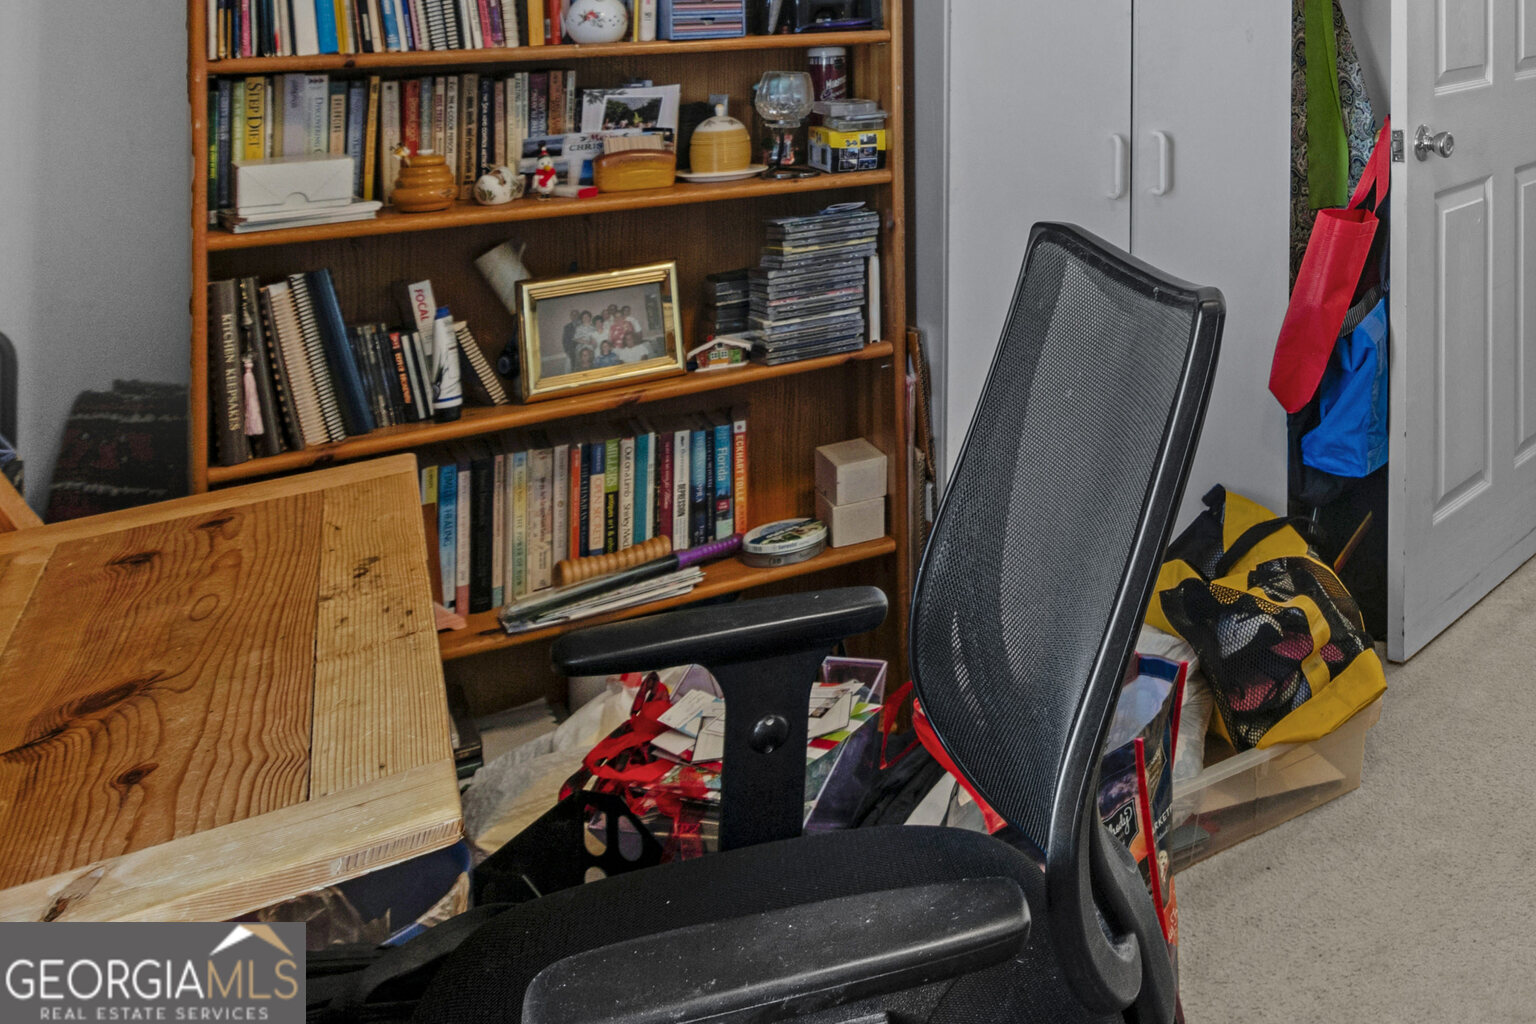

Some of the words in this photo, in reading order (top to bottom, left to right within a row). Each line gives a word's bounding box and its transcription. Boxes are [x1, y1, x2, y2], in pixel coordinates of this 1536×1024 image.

[246, 82, 262, 113] STEP
[247, 116, 262, 148] DIET
[569, 143, 603, 152] CHRIS
[414, 289, 430, 321] FOCAL
[221, 314, 235, 363] KITCHEN
[225, 368, 241, 431] KEEPSAKES
[717, 447, 728, 481] Florida
[736, 435, 745, 475] ECKHART
[593, 478, 604, 505] OPEN
[677, 483, 686, 517] DEPRESSION
[736, 477, 744, 501] TOLLE
[443, 509, 453, 547] HEALING
[593, 507, 603, 546] SECRETS
[619, 503, 631, 528] Shirley
